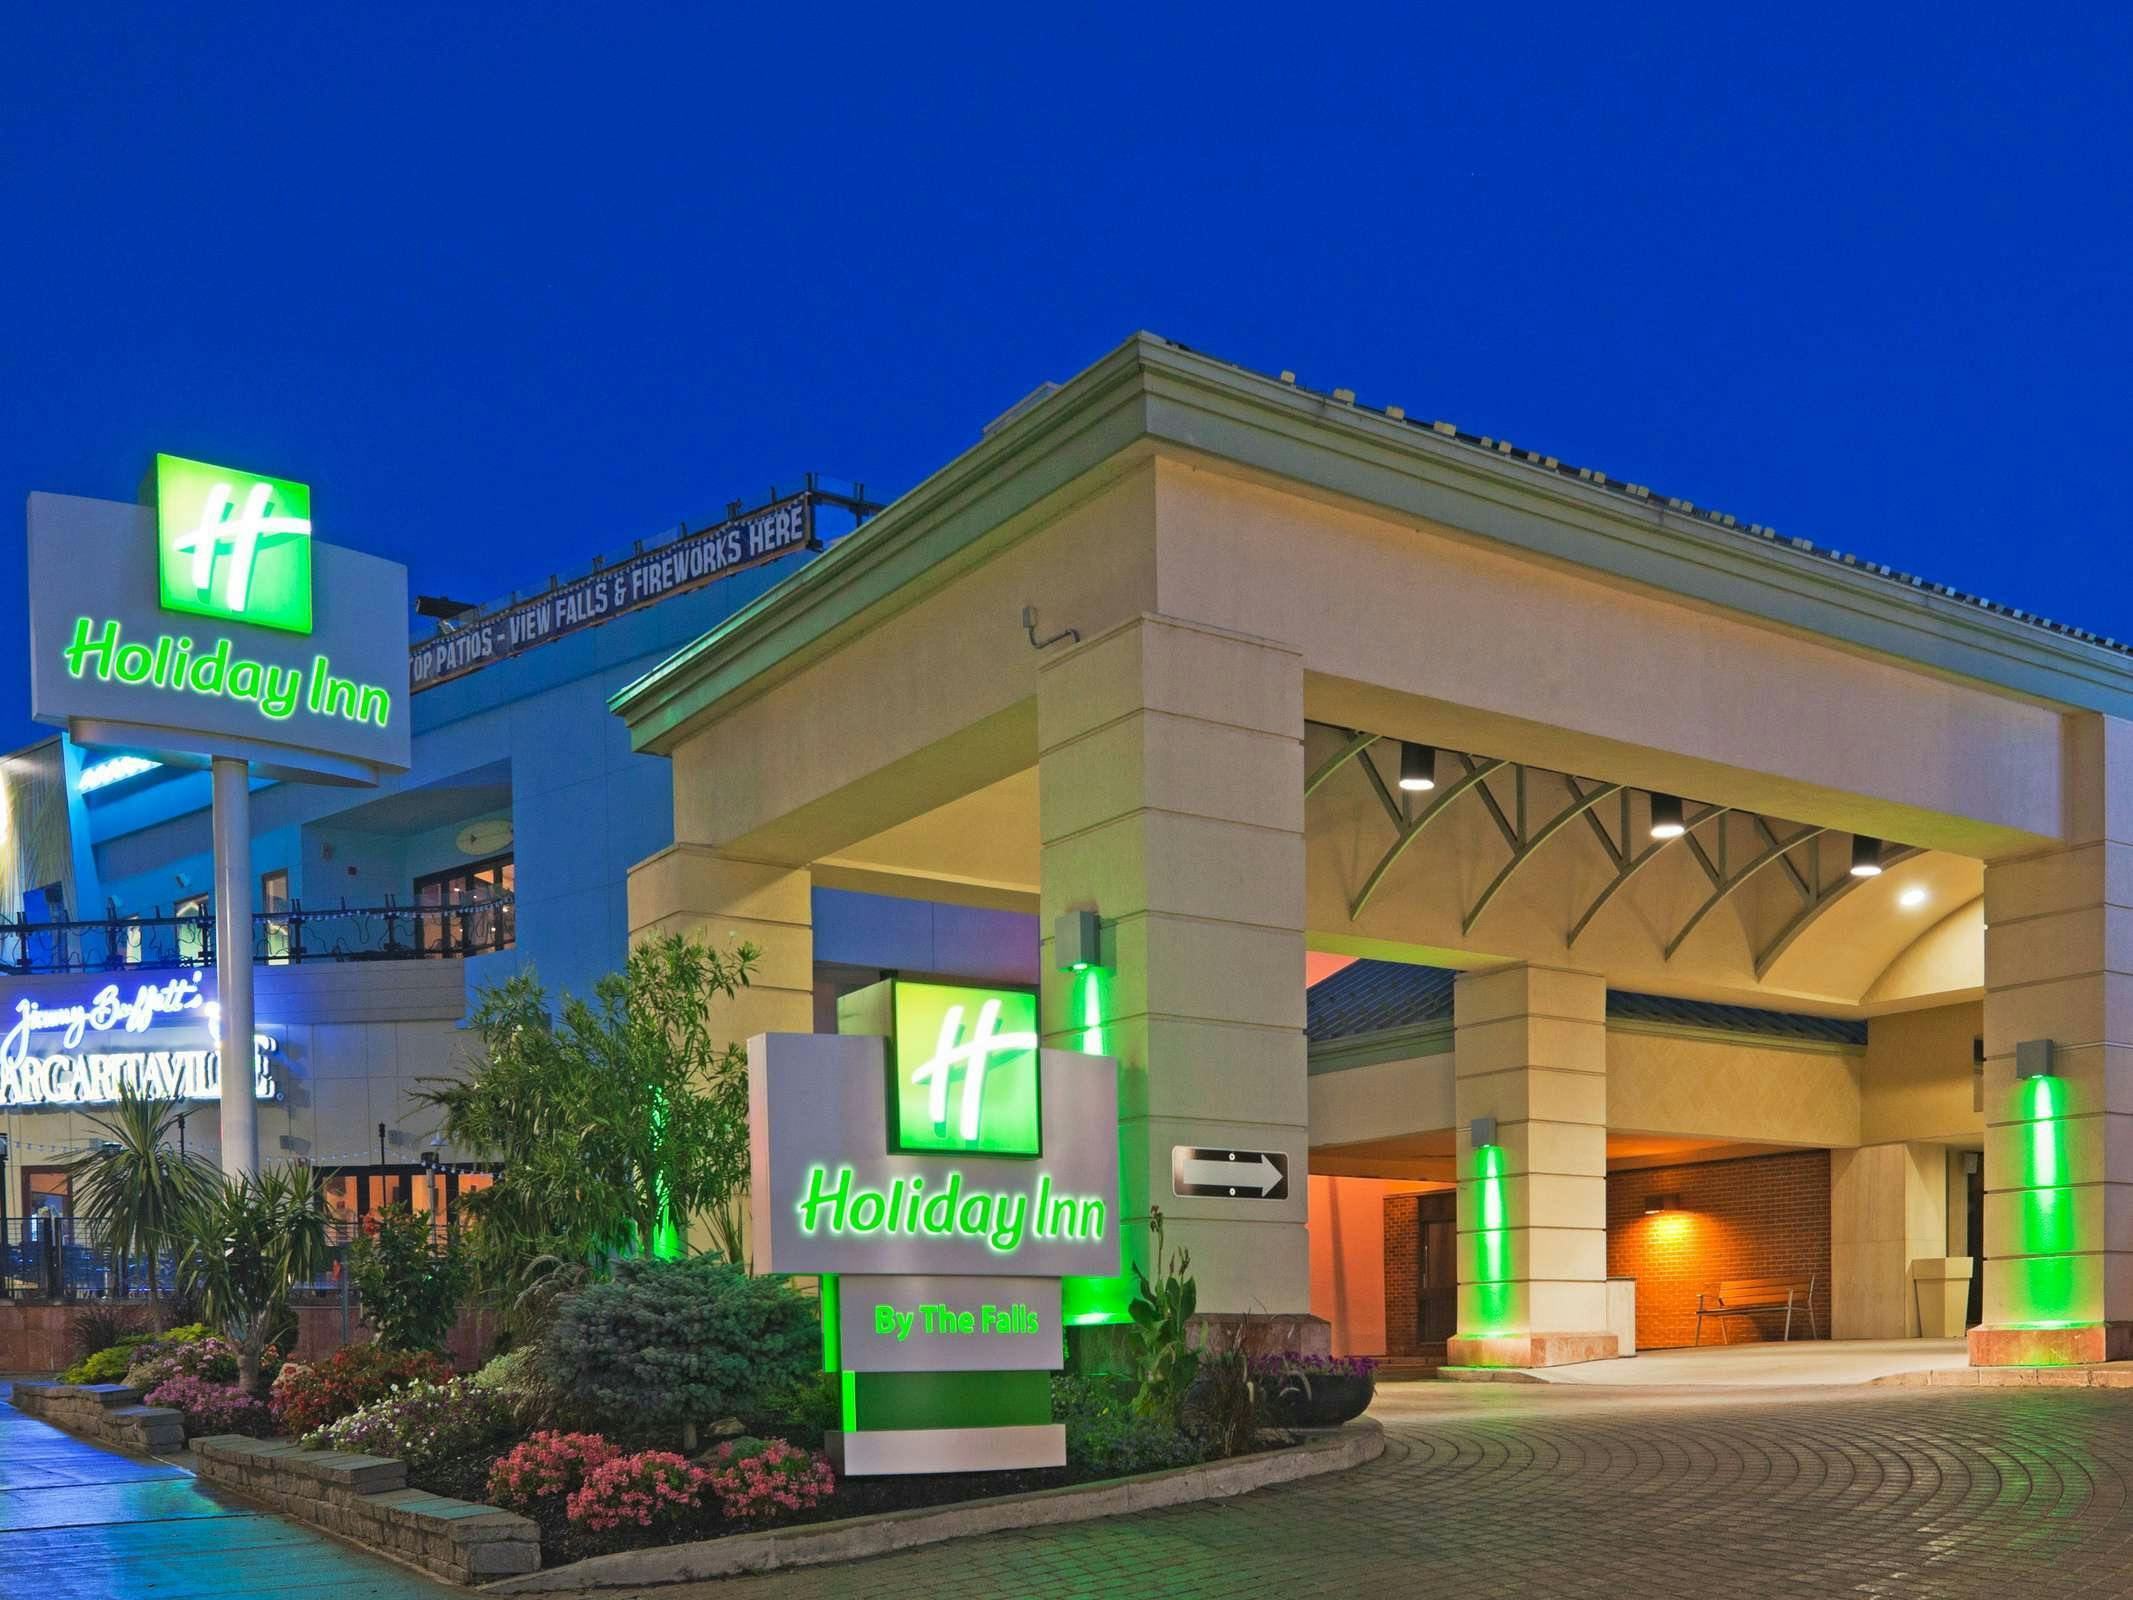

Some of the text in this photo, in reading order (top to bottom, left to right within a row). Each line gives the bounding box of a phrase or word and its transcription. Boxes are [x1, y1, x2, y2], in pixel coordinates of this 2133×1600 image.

[436, 628, 492, 673] PATIOS
[510, 602, 551, 648] VIEW
[555, 588, 608, 628] FALLS
[614, 581, 627, 604] &
[633, 531, 742, 601] FIREWORKS
[749, 505, 804, 557] HERE
[65, 617, 391, 727] Holiday Inn
[0, 1034, 276, 1105] ARGARITAVILE
[799, 1167, 1106, 1251] Holiday Inn
[875, 1304, 1039, 1342] By The Falls
